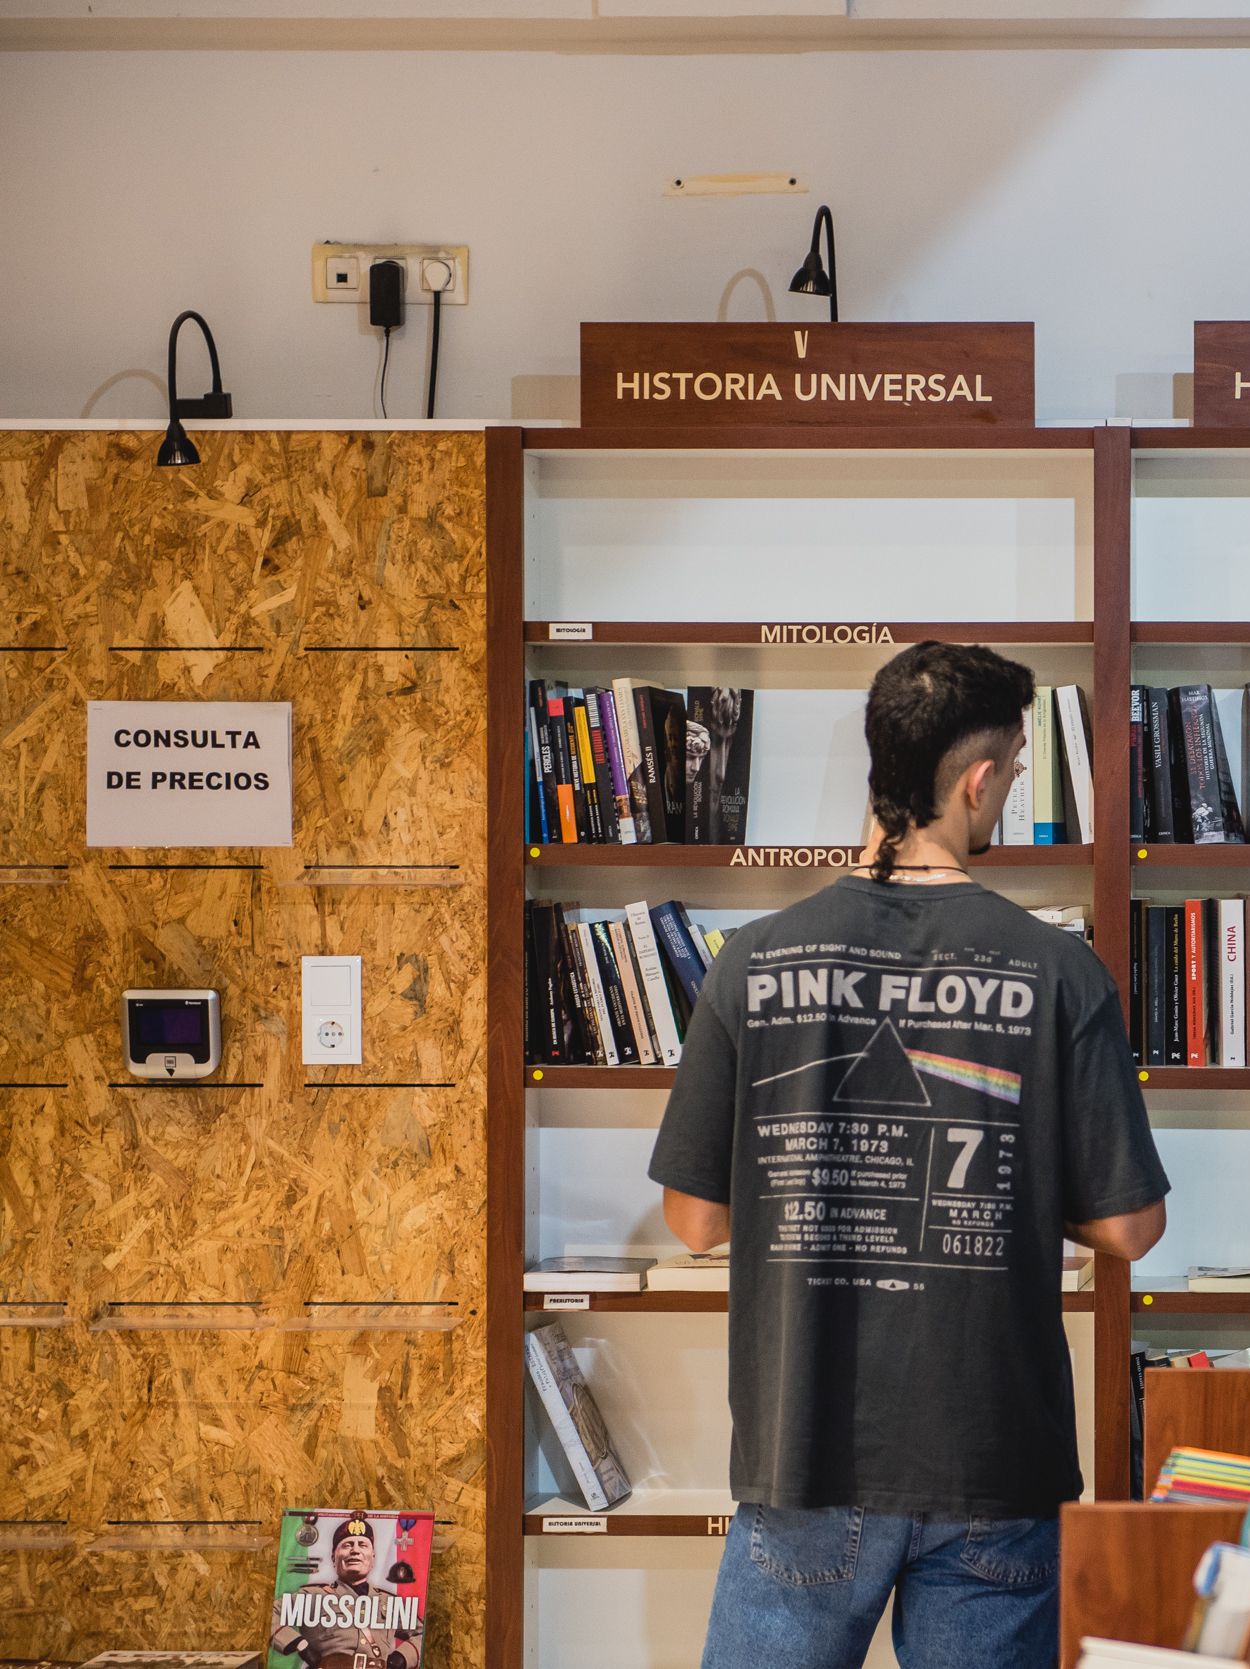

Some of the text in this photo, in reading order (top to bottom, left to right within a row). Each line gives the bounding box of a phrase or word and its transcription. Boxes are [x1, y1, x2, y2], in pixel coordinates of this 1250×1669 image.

[616, 373, 993, 402] HISTORIA UNIVERSAL
[761, 623, 895, 644] MITOLOGÍA
[1131, 690, 1140, 722] BEEVOR
[114, 729, 260, 749] CONSULTA
[1151, 702, 1162, 768] VASILI GROSSMAN
[1205, 723, 1213, 748] MUNDIAL
[645, 752, 656, 784] RAMSÉS
[106, 771, 270, 790] DE PRECIOS
[729, 848, 862, 867] ANTROPOL
[751, 944, 901, 960] AN EVENING OF SIGHT AND SOUND
[1227, 926, 1236, 962] CHINA
[1008, 959, 1038, 969] ADULT
[747, 968, 1034, 1019] PINK FLOYD
[747, 1012, 877, 1028] Gen. Adm. $12.50 Advance
[907, 1020, 950, 1029] Purchased
[952, 1020, 972, 1030] After
[974, 1021, 993, 1032] Mar.
[1008, 1025, 1032, 1036] 1973
[757, 1121, 909, 1138] WEDNESDAY 7:30 P.M.
[785, 1137, 889, 1153] MARCH 7, 1973
[865, 1155, 904, 1166] CHICAGO,
[947, 1128, 984, 1189] 7
[996, 1133, 1016, 1191] 1973
[811, 1167, 849, 1187] $9.50
[784, 1201, 887, 1221] $12.50 IN ADVANCE
[931, 1199, 976, 1209] WEDNESDAY
[949, 1209, 1002, 1221] MARCH
[963, 1220, 994, 1228] REFUNDS
[854, 1225, 898, 1234] ADMISSION
[865, 1234, 895, 1243] LEVELS
[870, 1245, 907, 1254] REFUNDS
[942, 1233, 1004, 1256] 061822
[852, 1278, 871, 1287] USA
[279, 1593, 419, 1630] MUSSOLINI
